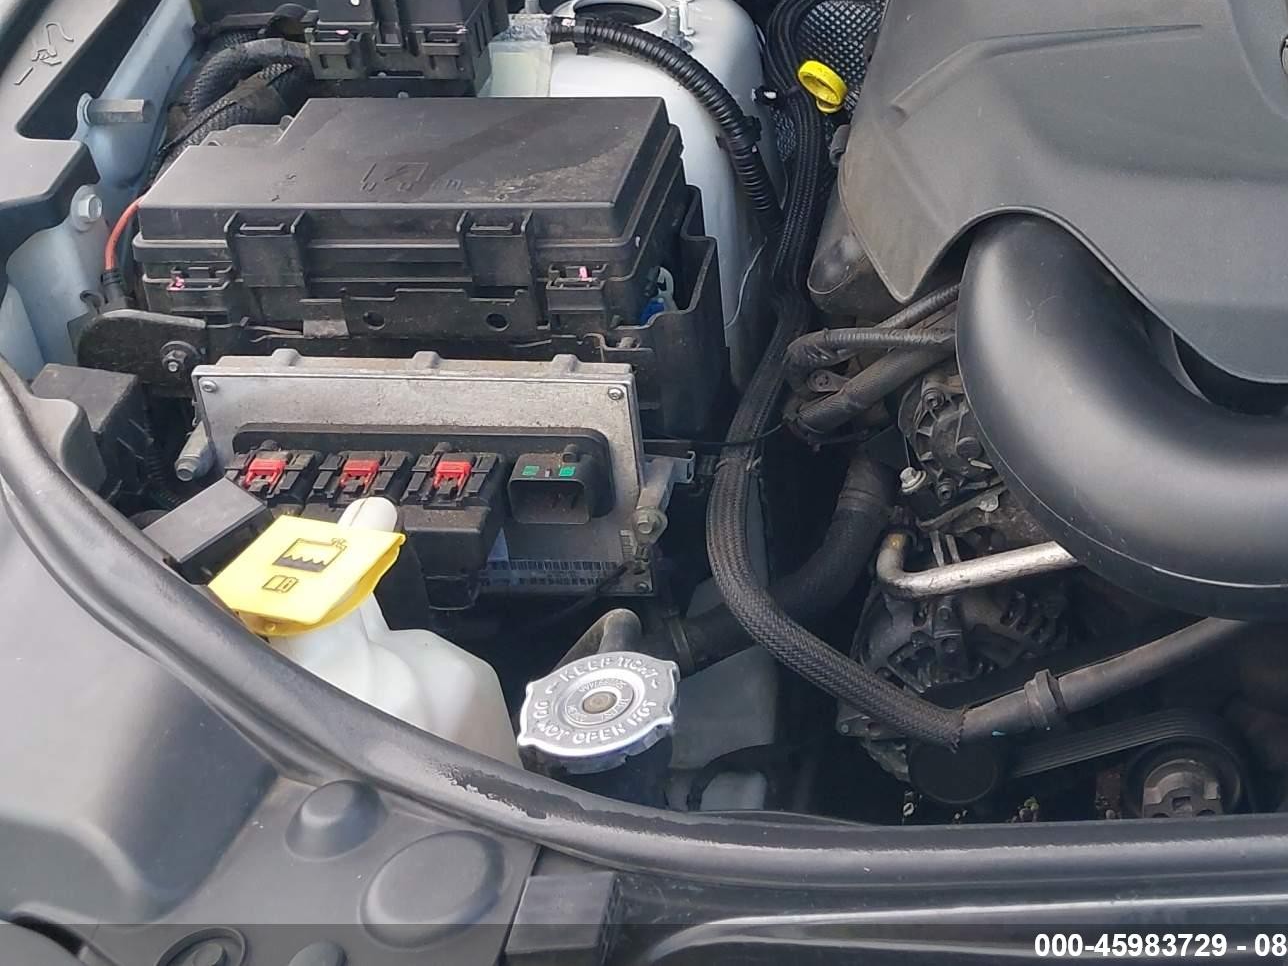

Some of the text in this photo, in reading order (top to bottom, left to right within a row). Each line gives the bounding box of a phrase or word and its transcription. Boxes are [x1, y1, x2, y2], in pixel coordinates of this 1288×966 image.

[558, 656, 612, 683] KEEP
[538, 720, 570, 740] NOT
[572, 724, 627, 745] OPEN
[626, 699, 657, 726] HOT
